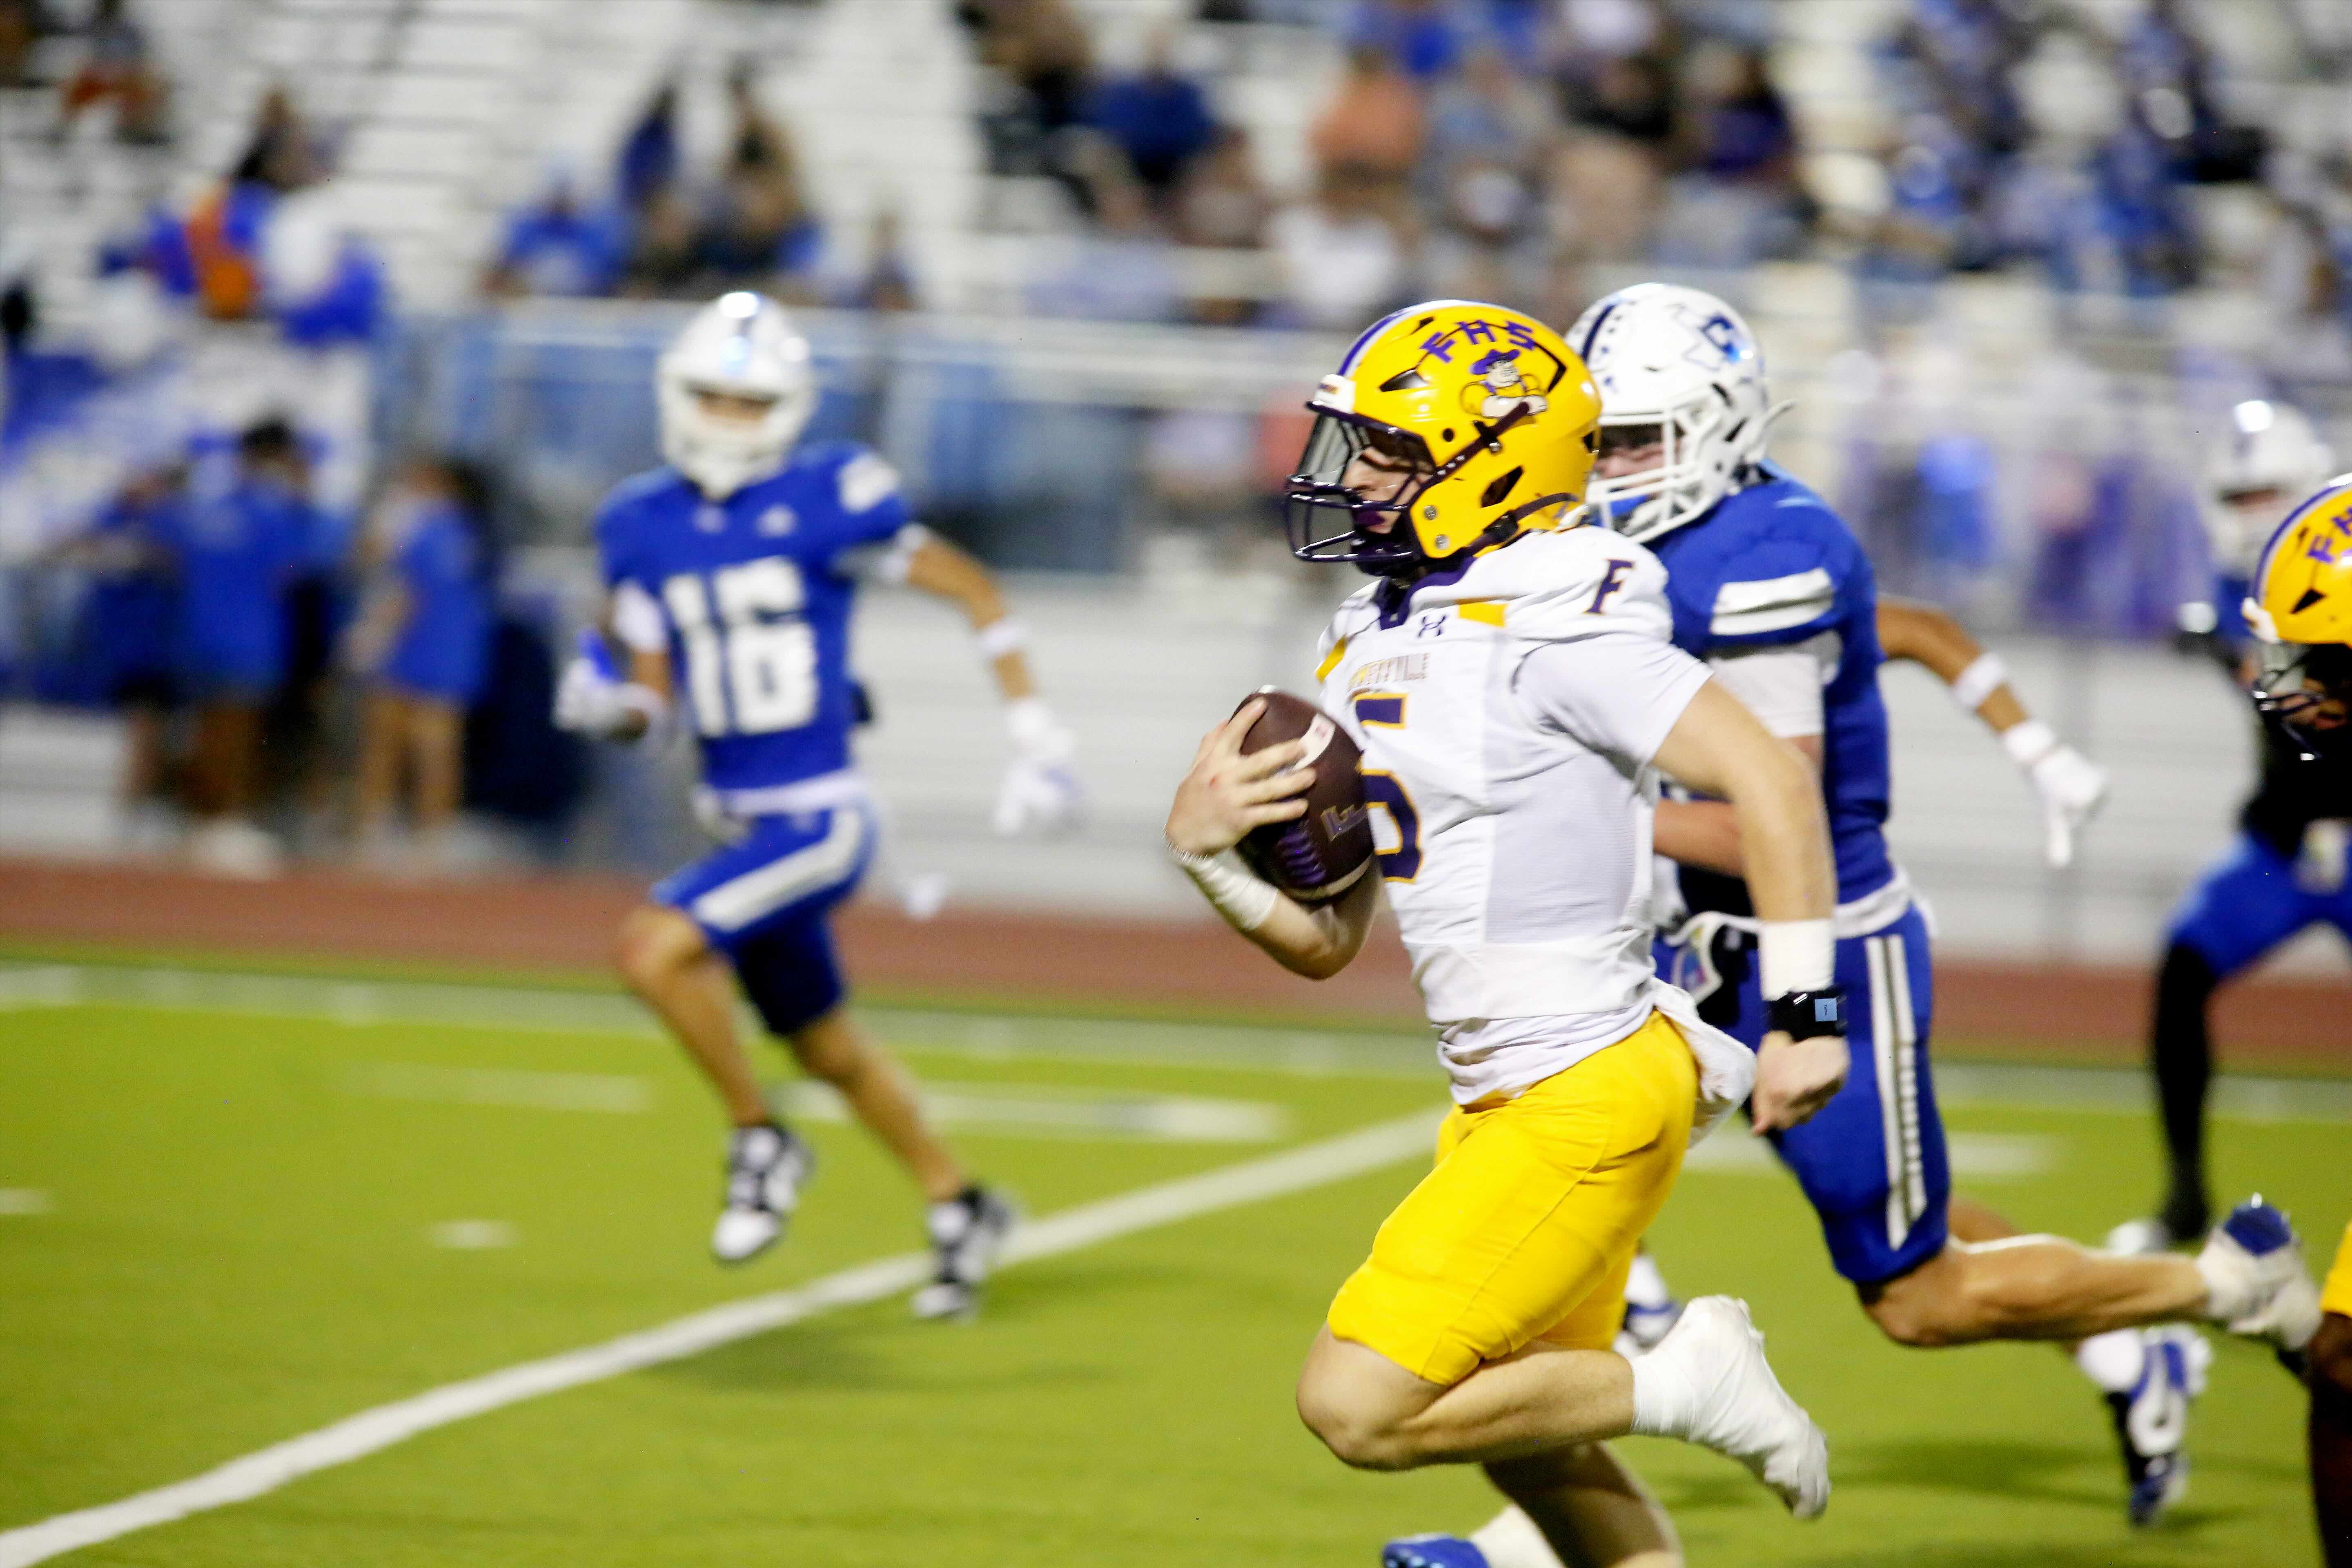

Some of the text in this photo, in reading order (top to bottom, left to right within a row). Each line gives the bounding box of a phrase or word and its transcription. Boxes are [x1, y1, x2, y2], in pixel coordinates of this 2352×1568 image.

[1419, 320, 1537, 363] FHS
[1582, 558, 1635, 615] F
[662, 555, 817, 737] 16
